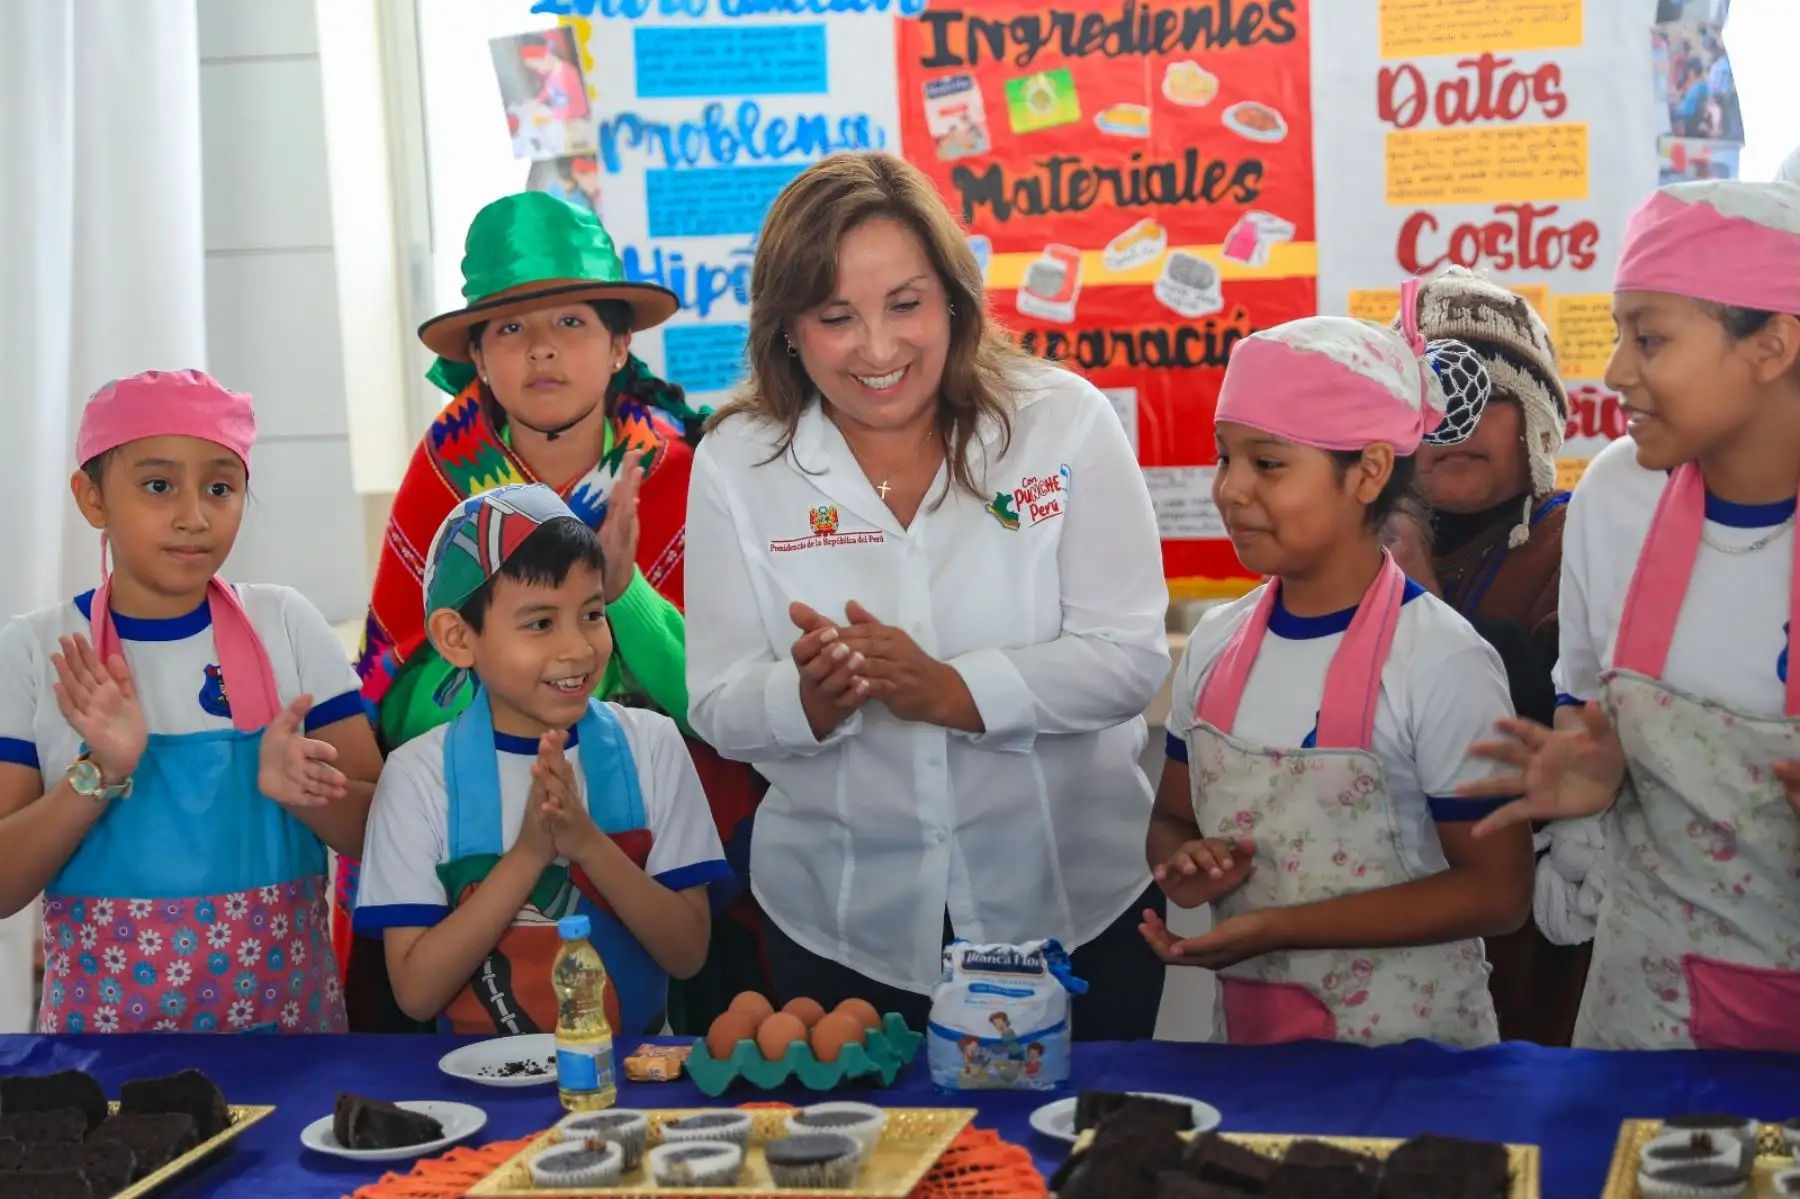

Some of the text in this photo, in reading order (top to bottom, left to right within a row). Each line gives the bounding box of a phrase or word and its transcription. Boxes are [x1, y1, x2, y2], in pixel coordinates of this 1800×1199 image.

[920, 0, 1298, 68] Ingredientes
[1377, 52, 1568, 129] Datos
[951, 147, 1264, 222] Materiales
[1396, 201, 1600, 276] Costos
[770, 542, 806, 552] Presidencia
[807, 540, 815, 548] de
[815, 538, 822, 546] la
[823, 536, 857, 547] República
[869, 534, 884, 543] Perú
